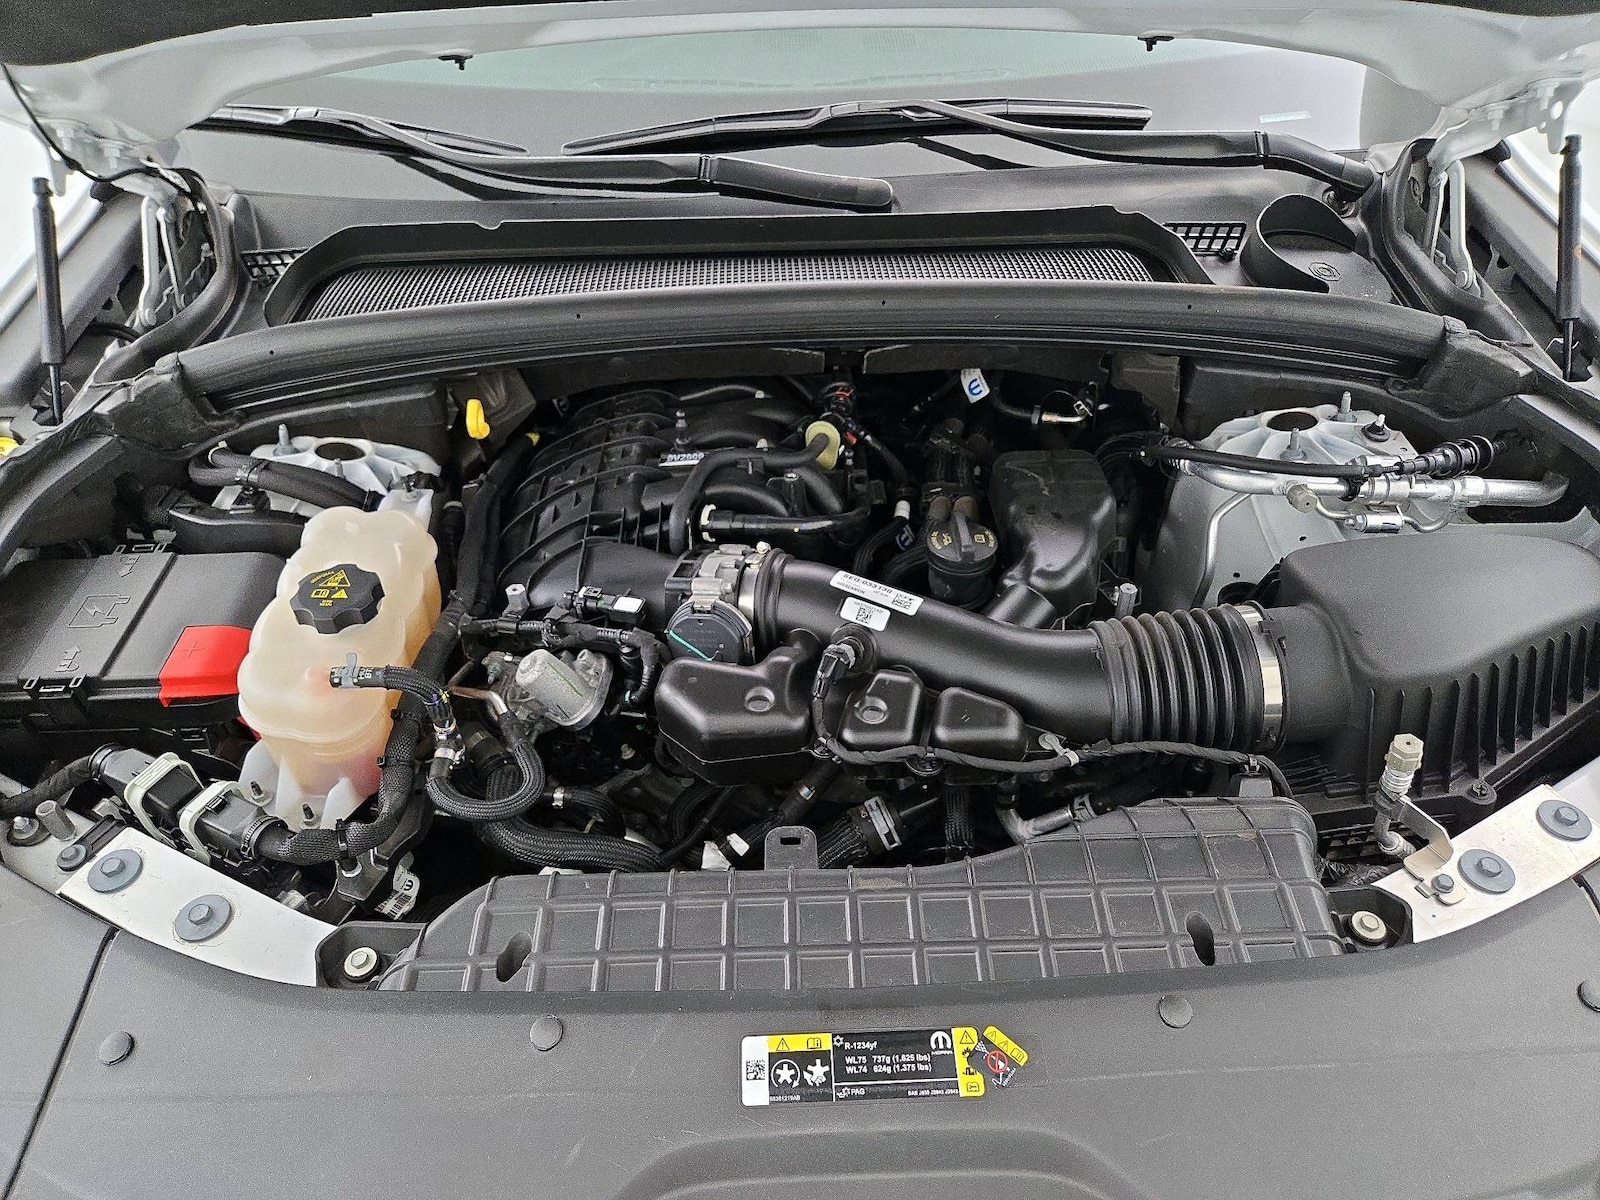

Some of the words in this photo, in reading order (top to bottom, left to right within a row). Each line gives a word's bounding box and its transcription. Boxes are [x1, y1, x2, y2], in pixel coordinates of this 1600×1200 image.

[844, 1041, 878, 1051] R-1234yf
[845, 1056, 867, 1064] WL75
[872, 1055, 891, 1064] 737g
[916, 1053, 931, 1063] lbs)
[845, 1066, 868, 1074] WL74
[873, 1065, 892, 1074] 624g
[893, 1063, 916, 1073] (1.375
[917, 1063, 932, 1072] lbs)
[851, 1088, 866, 1096] PAG
